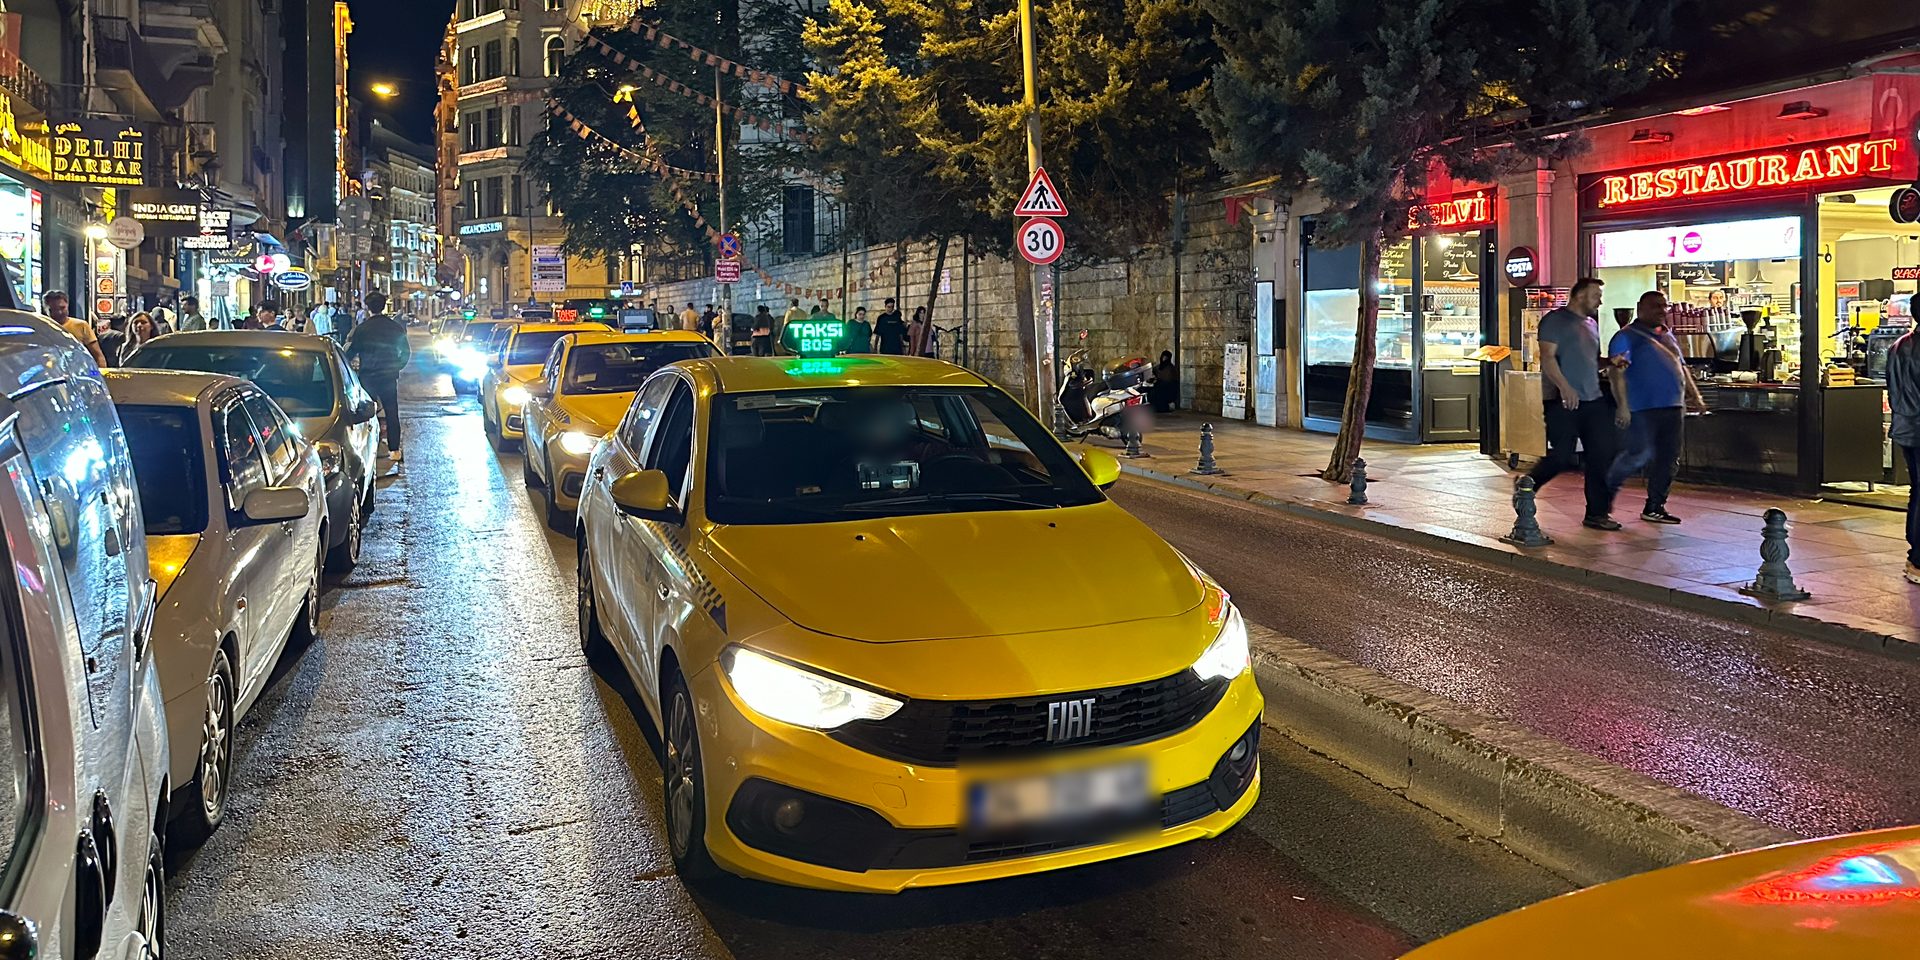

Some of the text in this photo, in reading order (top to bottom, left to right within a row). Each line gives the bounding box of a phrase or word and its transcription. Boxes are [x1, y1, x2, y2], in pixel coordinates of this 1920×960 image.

[54, 136, 143, 160] DELHI
[54, 156, 143, 175] DARBAR
[1603, 138, 1897, 204] RESTAURANT
[53, 171, 144, 185] Indian Restaurant
[133, 203, 197, 215] INDIA GATE
[1027, 229, 1054, 252] 30
[1505, 261, 1533, 273] COSTA
[1046, 698, 1095, 742] FIAT
